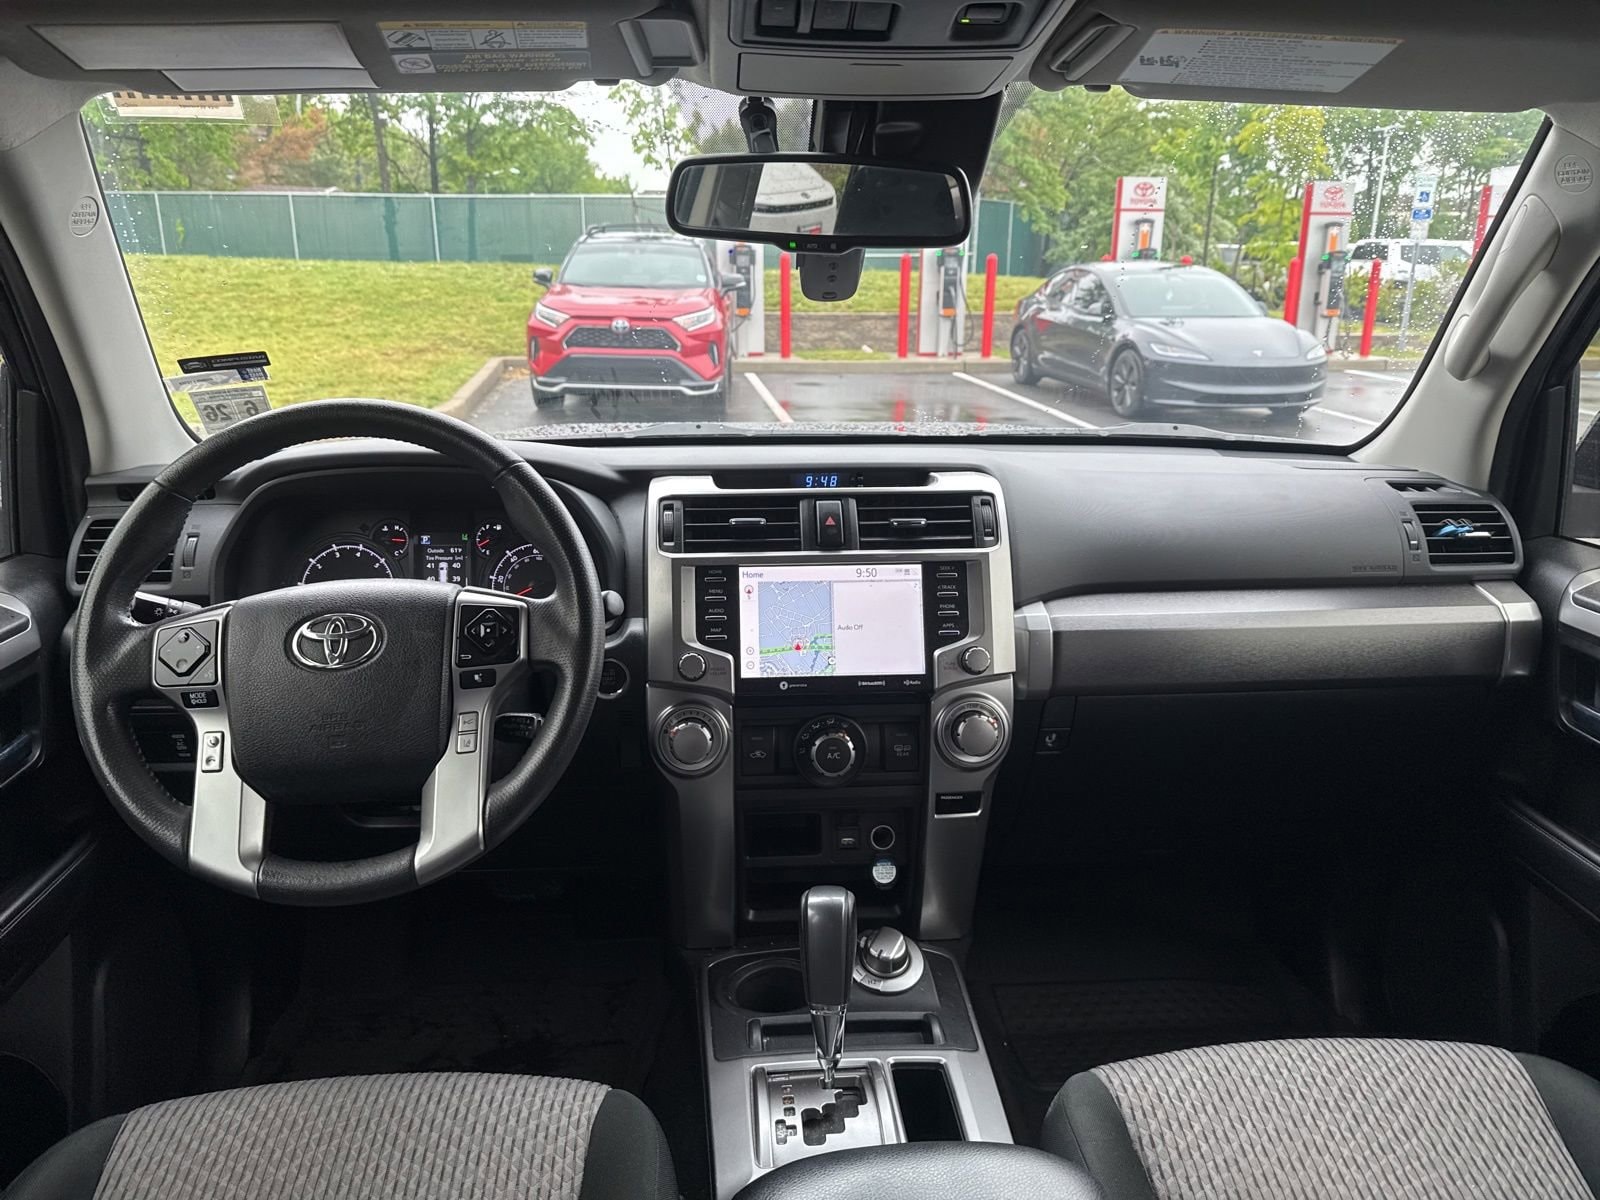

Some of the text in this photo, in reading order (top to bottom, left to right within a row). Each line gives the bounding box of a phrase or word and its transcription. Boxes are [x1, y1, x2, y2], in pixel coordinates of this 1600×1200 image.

[805, 475, 838, 488] 9:48
[742, 570, 764, 579] Home
[855, 567, 878, 578] 9:50
